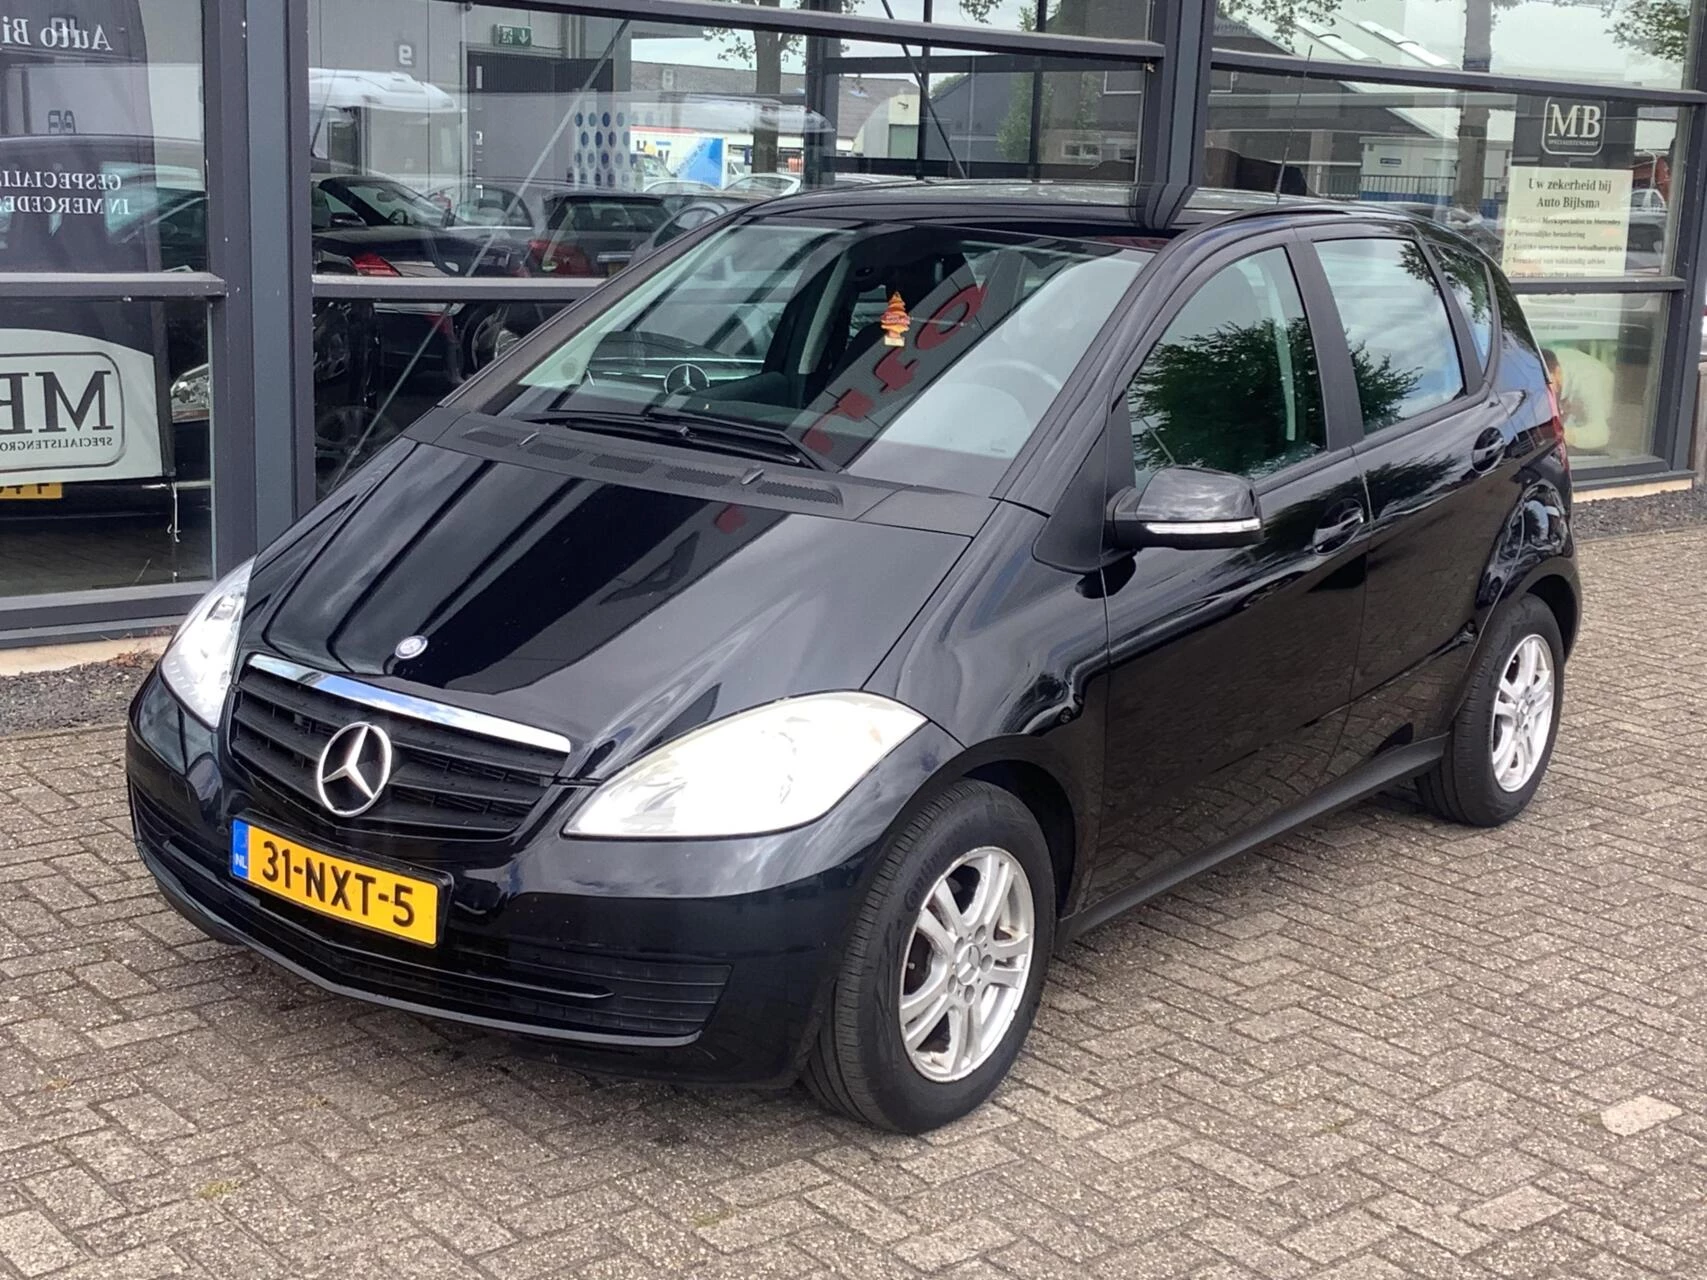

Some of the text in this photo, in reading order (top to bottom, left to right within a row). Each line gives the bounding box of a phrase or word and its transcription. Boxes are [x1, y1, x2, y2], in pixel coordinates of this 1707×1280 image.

[1548, 104, 1601, 138] MB
[1547, 179, 1596, 191] zekerheid
[1598, 180, 1612, 194] bij
[1536, 197, 1560, 208] Auto
[235, 840, 415, 928] NL 31-NXT-5
